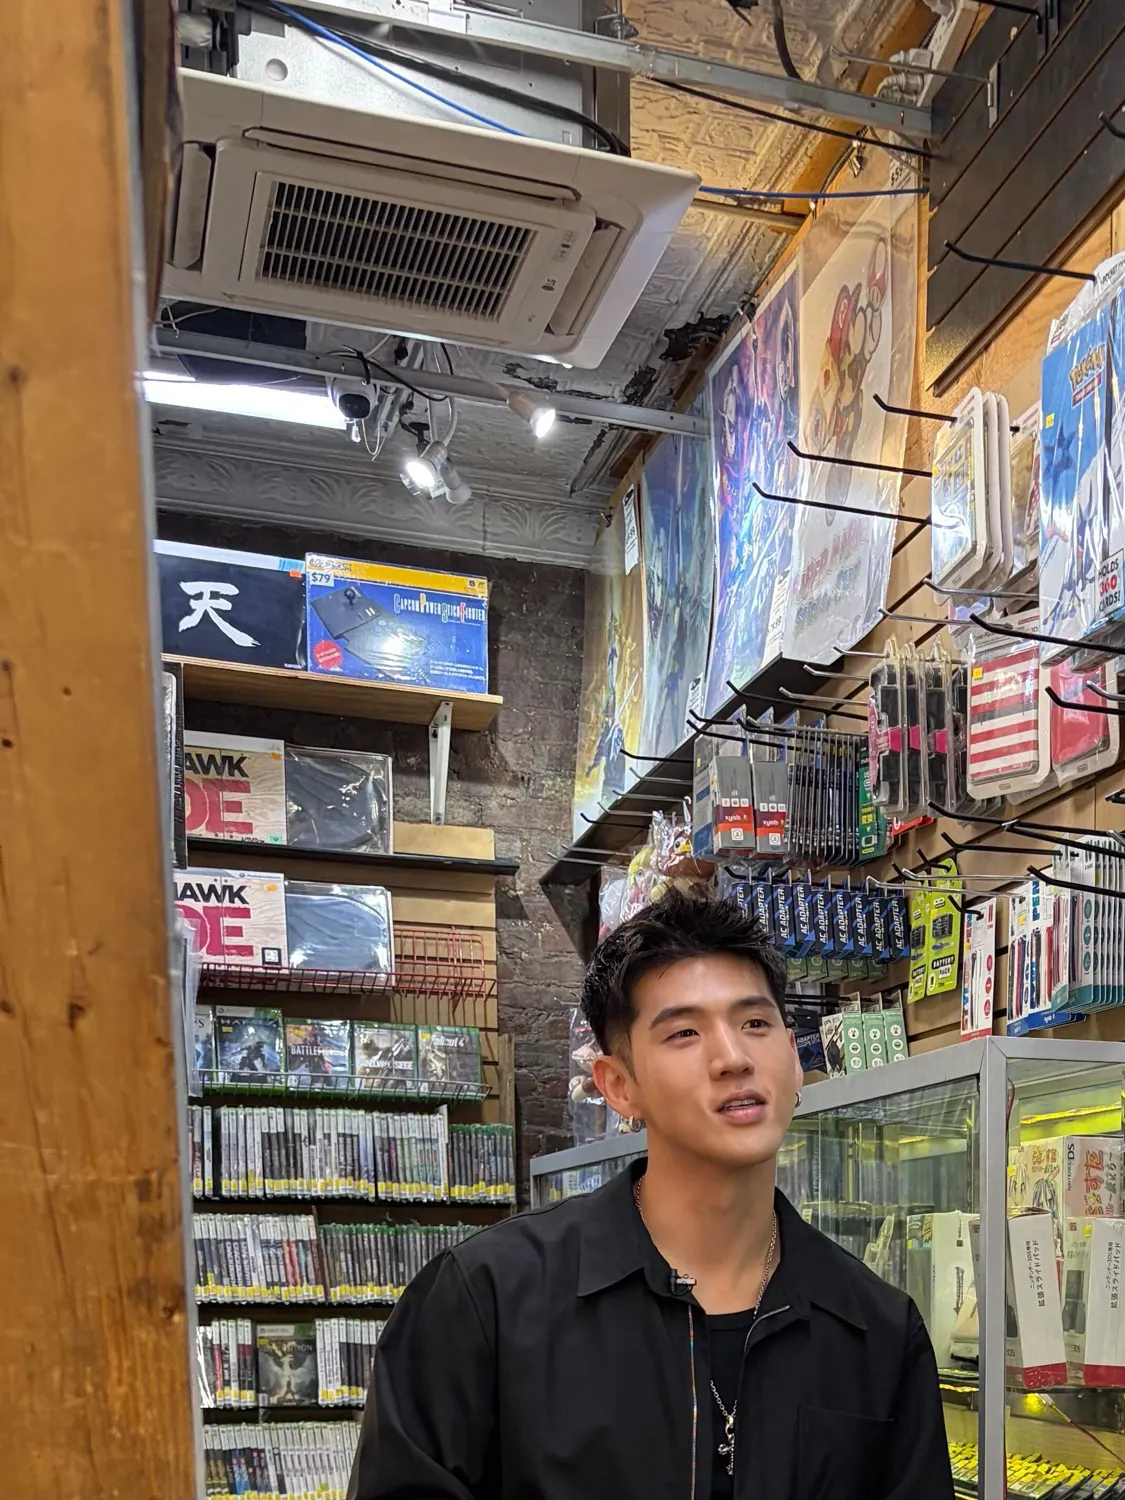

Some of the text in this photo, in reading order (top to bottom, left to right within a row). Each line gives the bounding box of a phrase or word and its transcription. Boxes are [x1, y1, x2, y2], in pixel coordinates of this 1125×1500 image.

[311, 572, 331, 583] $79
[178, 580, 261, 648] 天
[777, 885, 786, 925] ADAPTER
[797, 885, 806, 921] ADAPTER
[816, 892, 828, 930] ADAPTER
[836, 893, 846, 931] ADAPTER
[854, 896, 863, 934] ADAPTER
[891, 900, 900, 936] ADAPTER
[1032, 879, 1040, 922] PEN
[873, 901, 882, 938] ADAPTER
[932, 955, 955, 969] BATTERY
[939, 967, 952, 978] PACK
